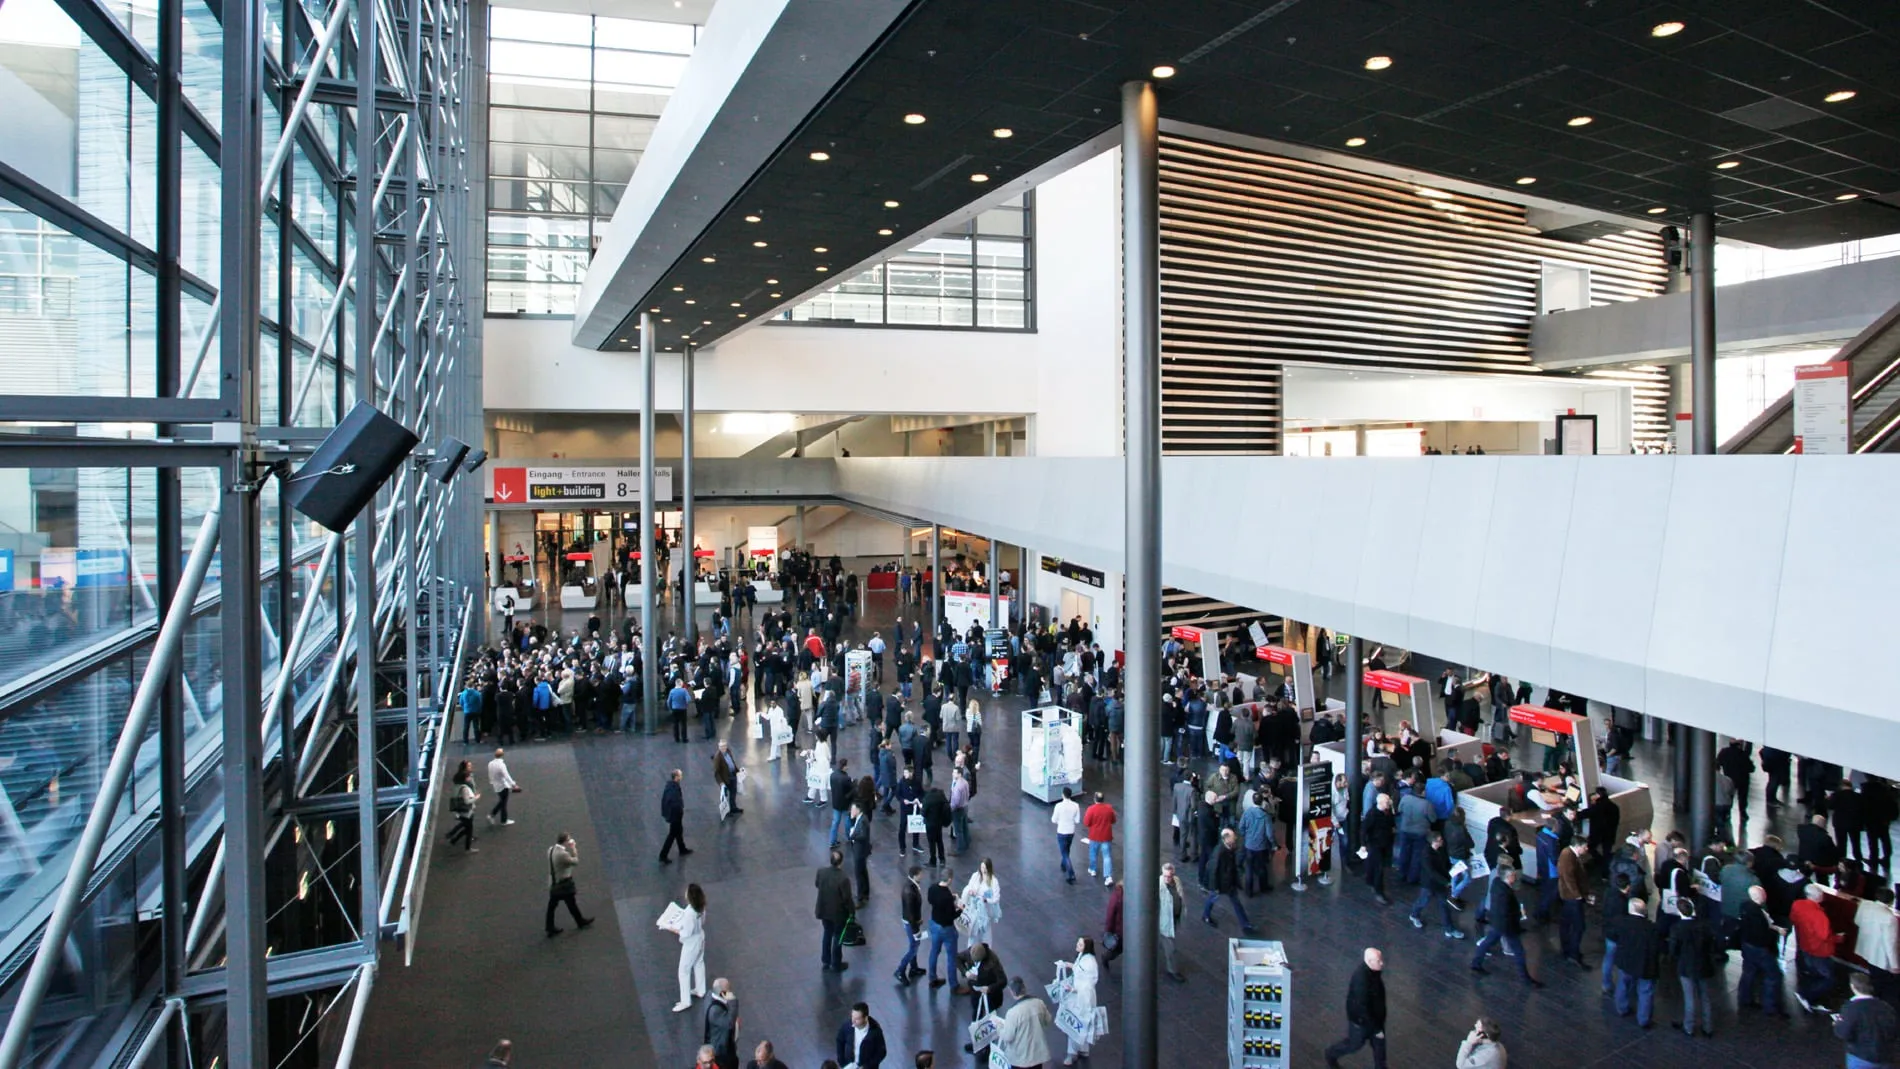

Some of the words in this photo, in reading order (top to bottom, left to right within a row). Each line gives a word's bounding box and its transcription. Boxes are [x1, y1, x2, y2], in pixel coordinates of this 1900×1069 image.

[529, 470, 562, 479] Eingang
[571, 470, 606, 478] Entrance
[533, 485, 602, 498] light+building
[1060, 1011, 1083, 1034] KNX
[974, 1023, 997, 1042] KNX
